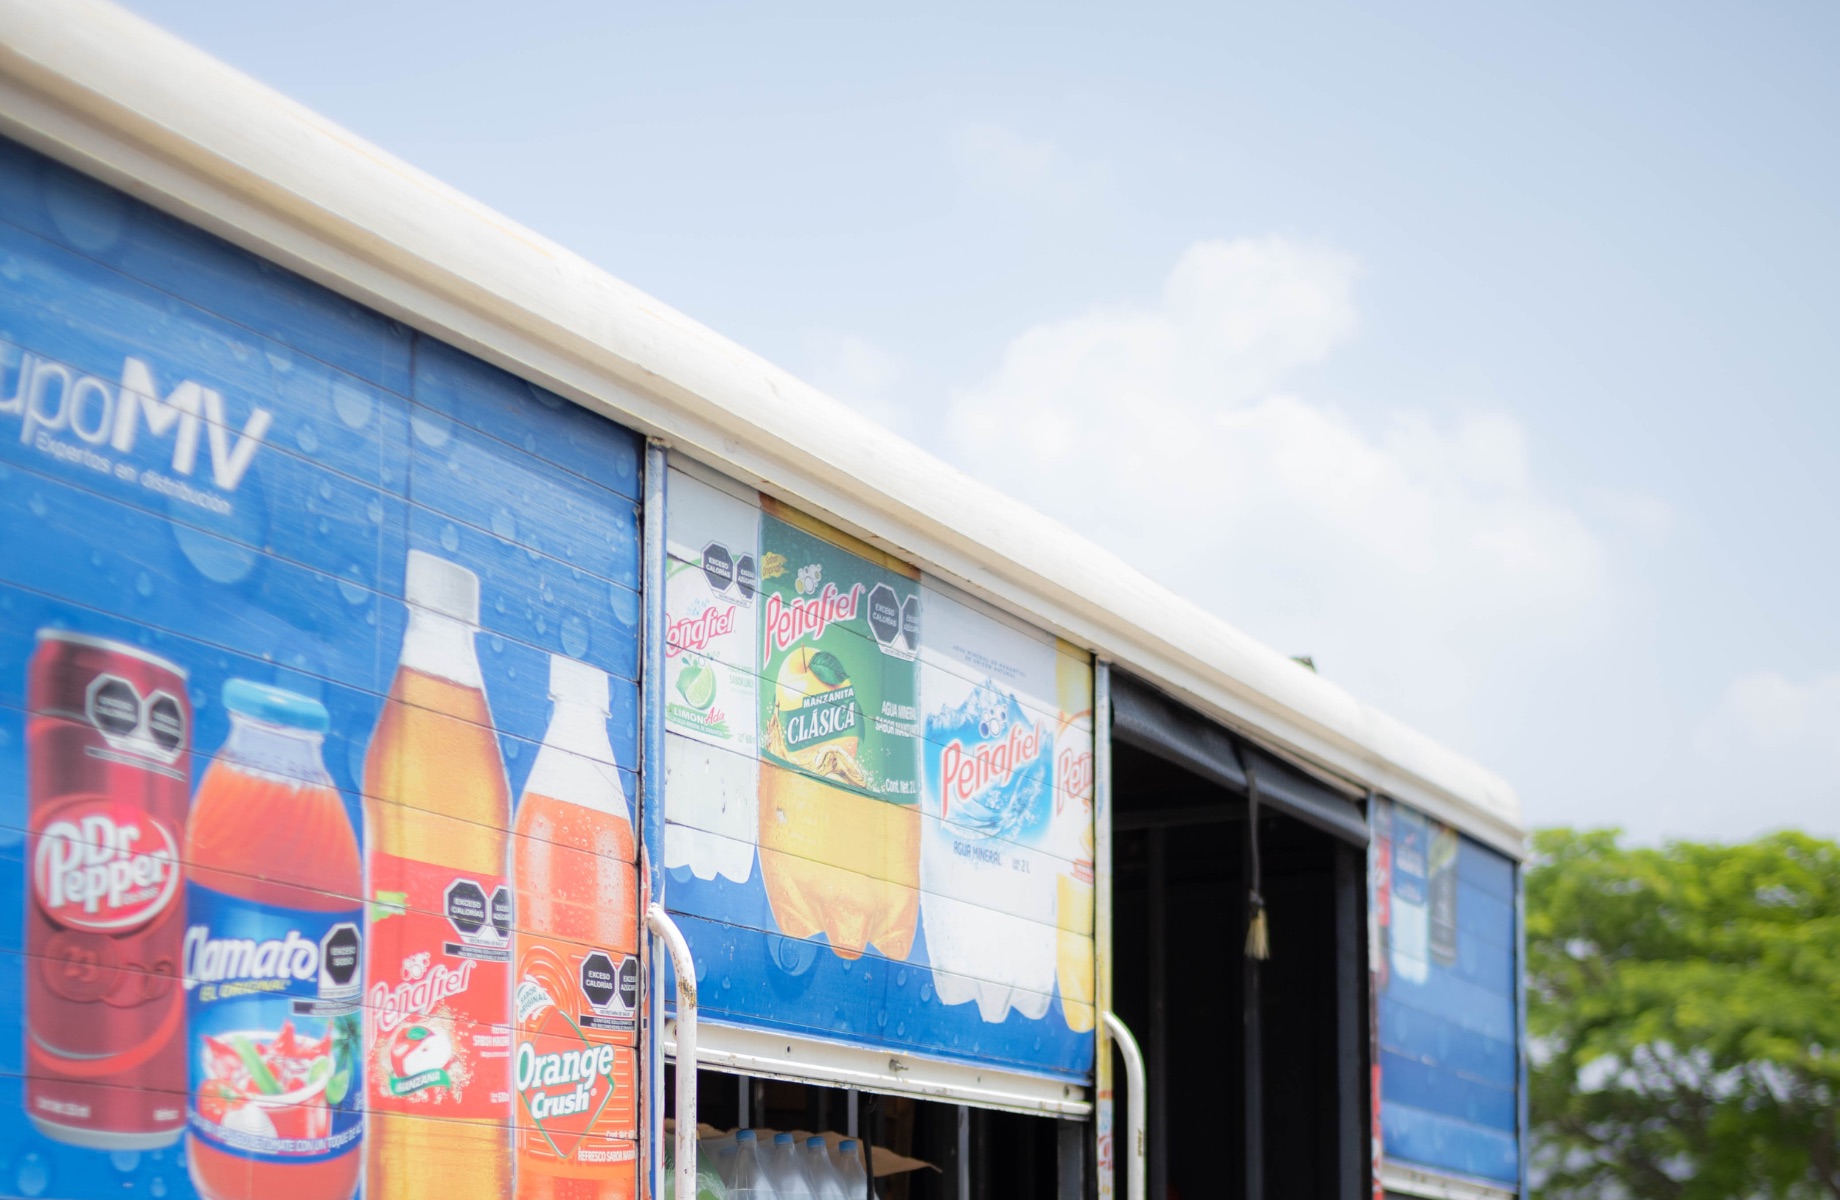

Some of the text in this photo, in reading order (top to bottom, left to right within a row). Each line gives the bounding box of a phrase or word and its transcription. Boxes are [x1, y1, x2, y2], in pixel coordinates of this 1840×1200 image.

[709, 556, 729, 570] EXCESO
[763, 582, 862, 671] Peñafiel
[875, 603, 896, 617] EXCESO
[666, 605, 737, 658] eñafiel
[803, 687, 855, 709] MANZANITA
[787, 702, 856, 745] CLÁSICA
[940, 720, 1040, 821] Peñafiel
[81, 814, 141, 865] Dr
[40, 820, 170, 915] Pepper
[453, 897, 482, 909] EXCESO
[182, 925, 319, 990] Clamato
[588, 970, 611, 981] EXCESO
[585, 979, 613, 990] CALORÍAS
[395, 1070, 441, 1093] MANZANA
[516, 1043, 615, 1091] Orange
[532, 1082, 591, 1120] Crush
